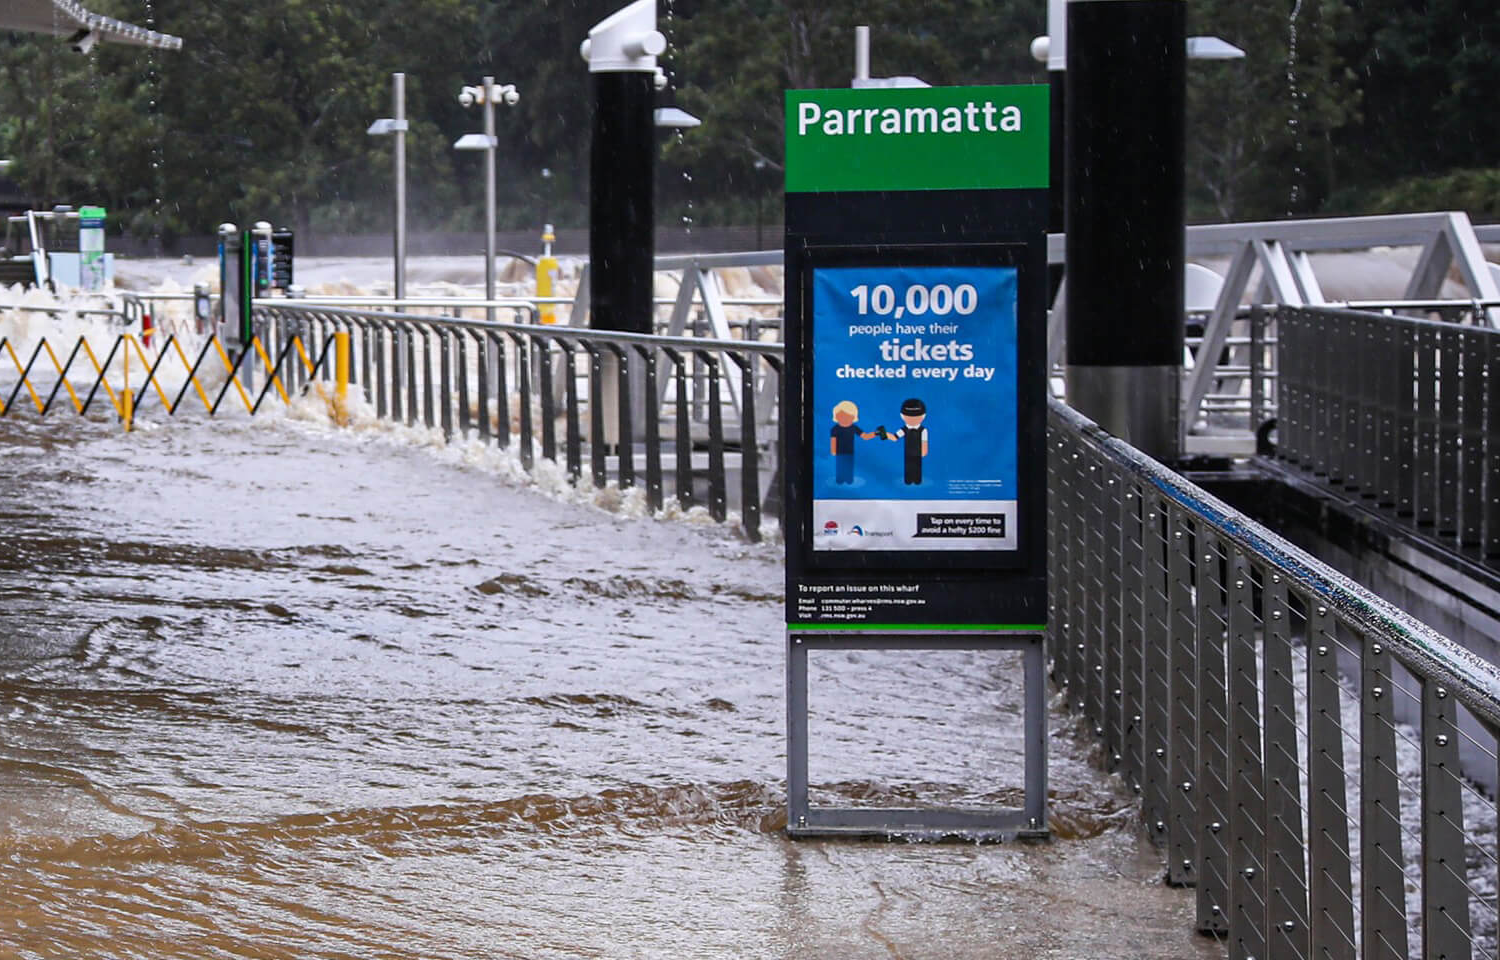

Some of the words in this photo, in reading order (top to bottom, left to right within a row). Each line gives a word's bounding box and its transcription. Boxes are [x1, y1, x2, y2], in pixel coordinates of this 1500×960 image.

[799, 101, 1022, 136] Parramatta
[850, 284, 978, 319] 10,000
[849, 322, 893, 337] people
[896, 322, 926, 335] have
[930, 322, 959, 335] their
[880, 338, 974, 361] tickets
[836, 365, 906, 378] checked
[912, 367, 959, 381] every
[964, 364, 995, 381] day
[931, 517, 943, 525] Tap
[948, 526, 967, 535] hefty
[987, 526, 1001, 534] fine
[799, 584, 808, 592] To
[809, 584, 834, 594] report
[846, 584, 867, 592] issue
[880, 584, 895, 592] this
[896, 584, 919, 592] wharf
